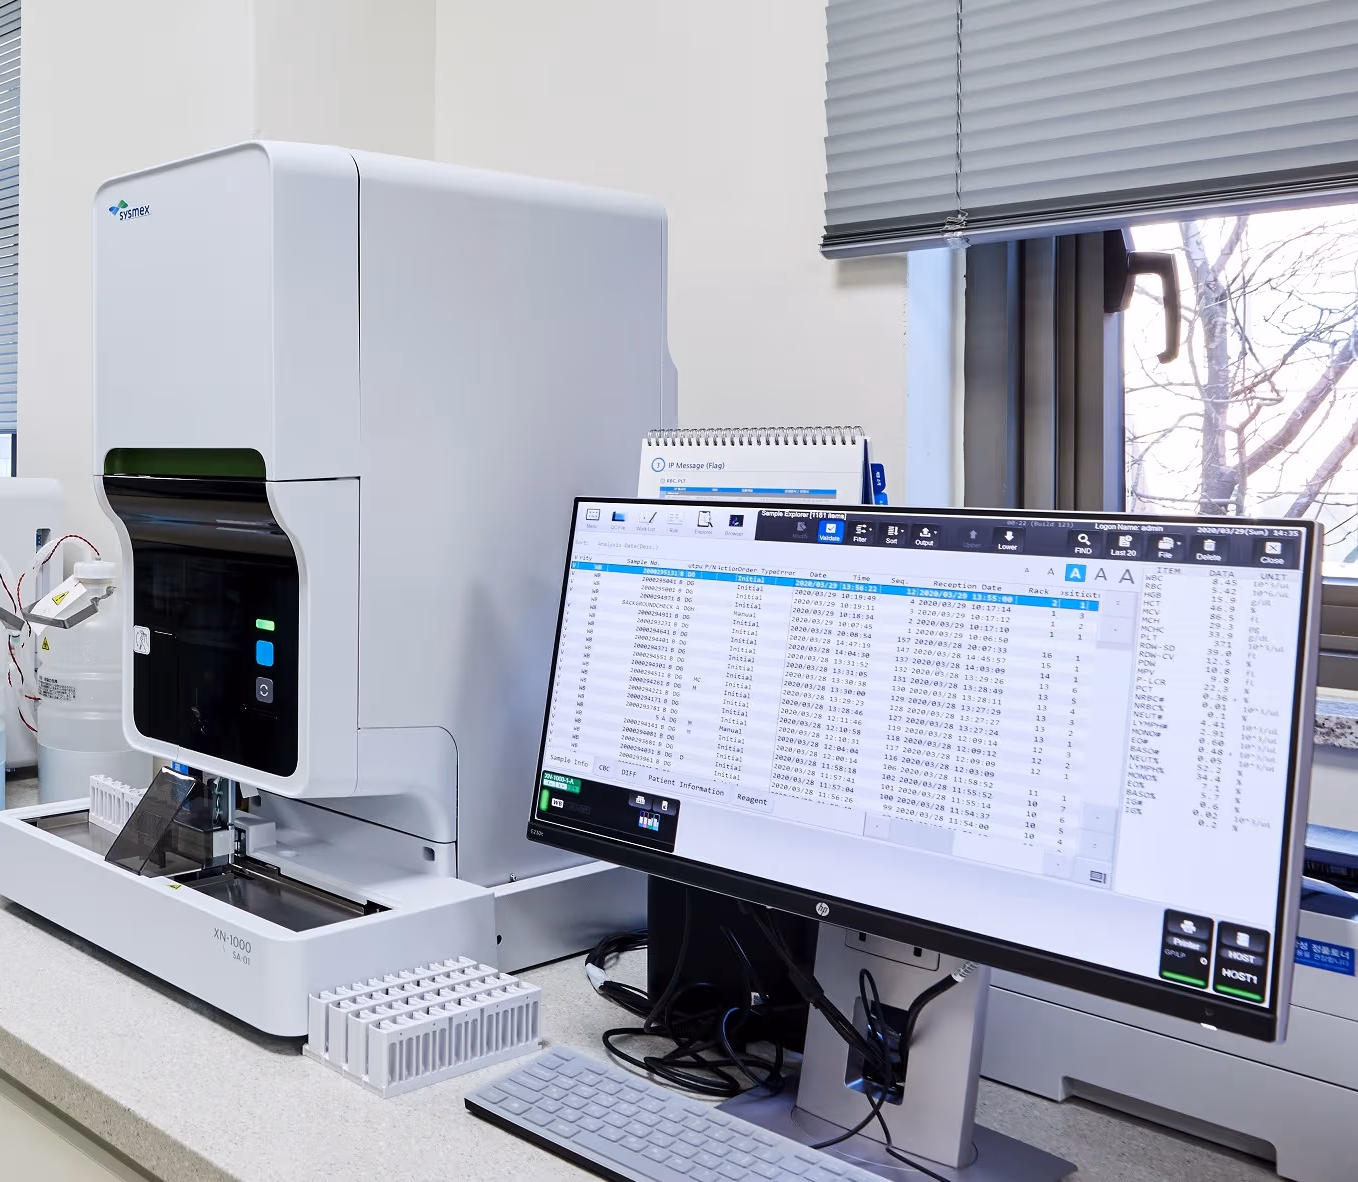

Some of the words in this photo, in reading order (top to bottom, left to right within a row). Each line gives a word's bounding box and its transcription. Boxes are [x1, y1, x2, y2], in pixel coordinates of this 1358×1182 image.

[119, 204, 151, 221] sysmex
[676, 462, 704, 470] Message
[706, 462, 725, 470] (Flag)
[1196, 552, 1221, 561] Delete
[1260, 556, 1284, 564] Close
[1156, 566, 1181, 575] ITEM
[1208, 569, 1235, 578] DATA
[933, 580, 976, 589] Reception
[550, 754, 570, 763] Sample
[621, 769, 636, 777] DIFF
[648, 774, 675, 785] Patient
[679, 781, 724, 795] Information
[737, 793, 767, 805] Reagent
[214, 928, 252, 954] XN-1000
[1228, 950, 1255, 963] HOST
[1222, 967, 1257, 984] HOST1
